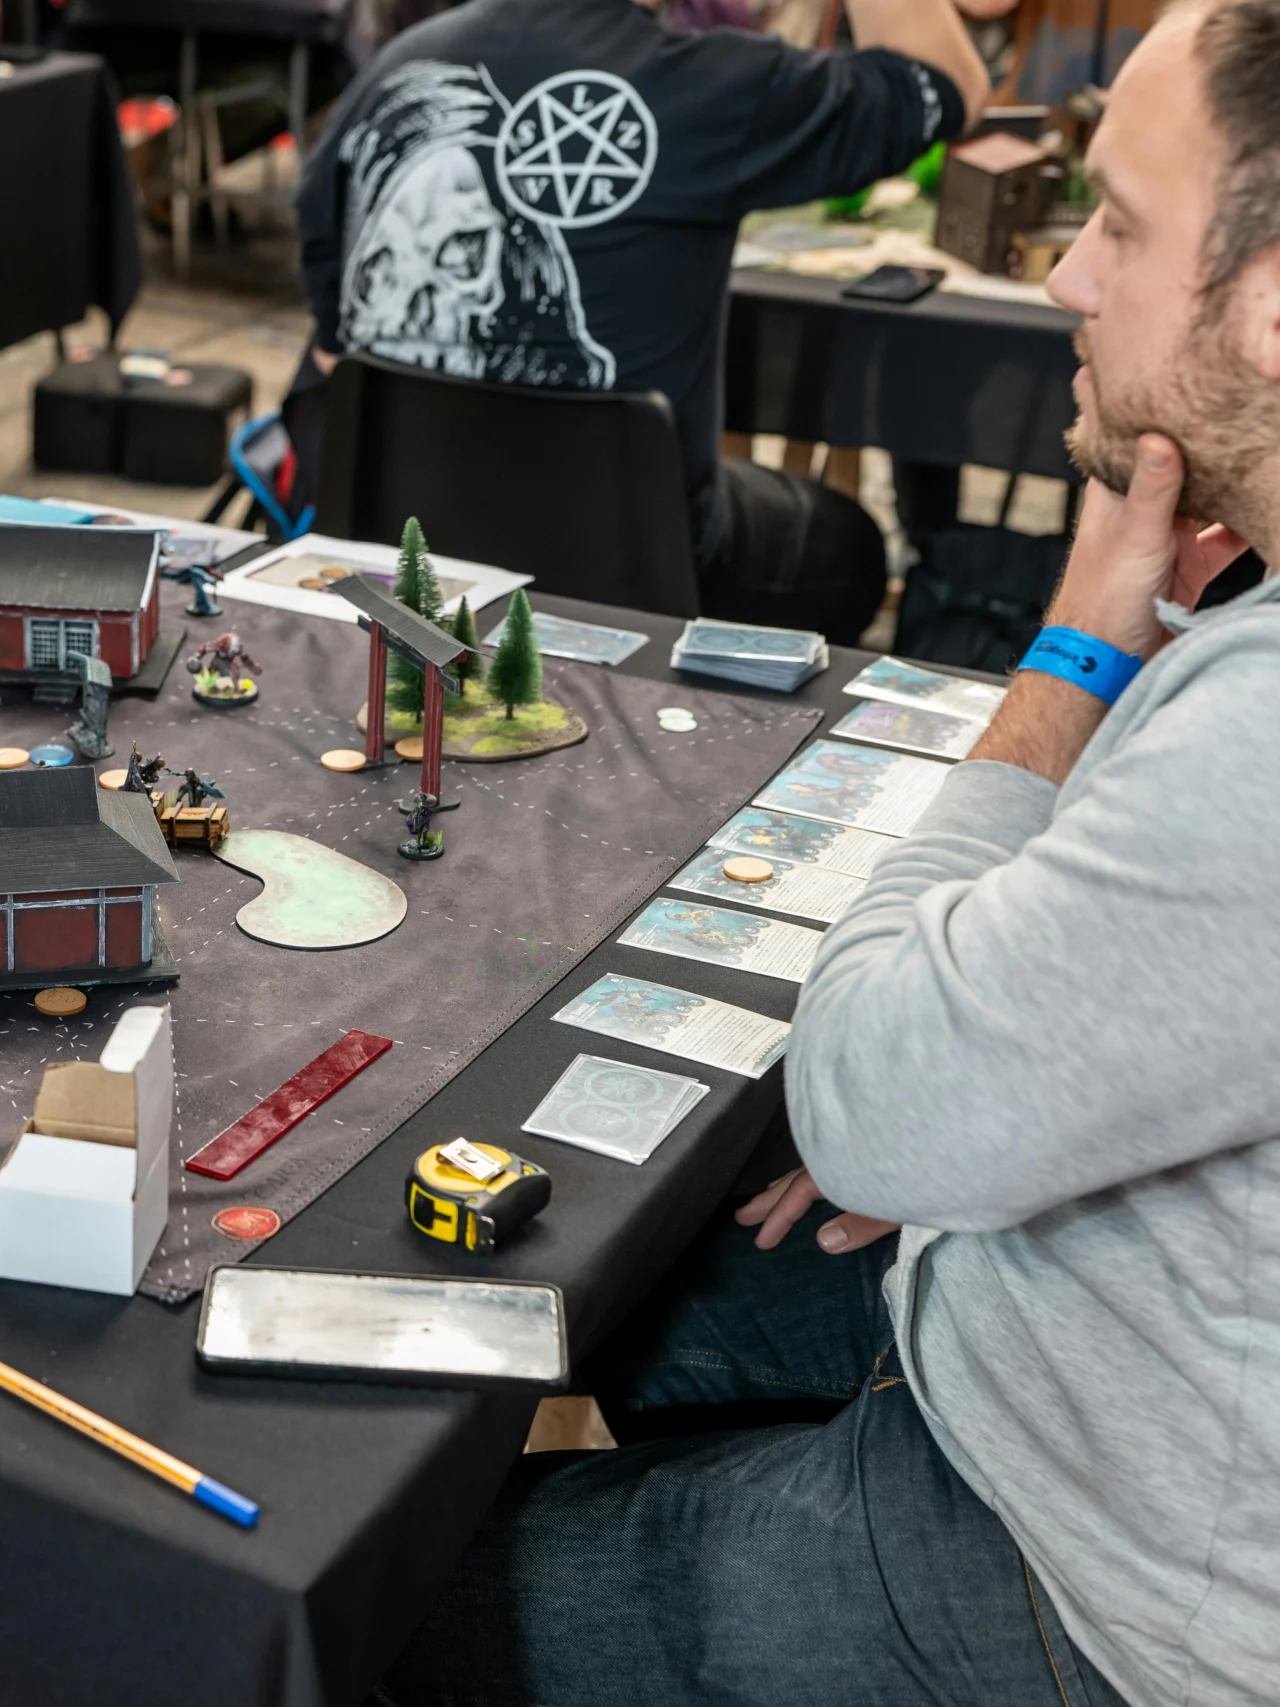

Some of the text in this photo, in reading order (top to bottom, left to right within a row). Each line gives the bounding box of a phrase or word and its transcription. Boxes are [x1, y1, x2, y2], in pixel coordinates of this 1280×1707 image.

[516, 119, 536, 148] S
[617, 120, 642, 149] Z
[588, 177, 617, 206] R
